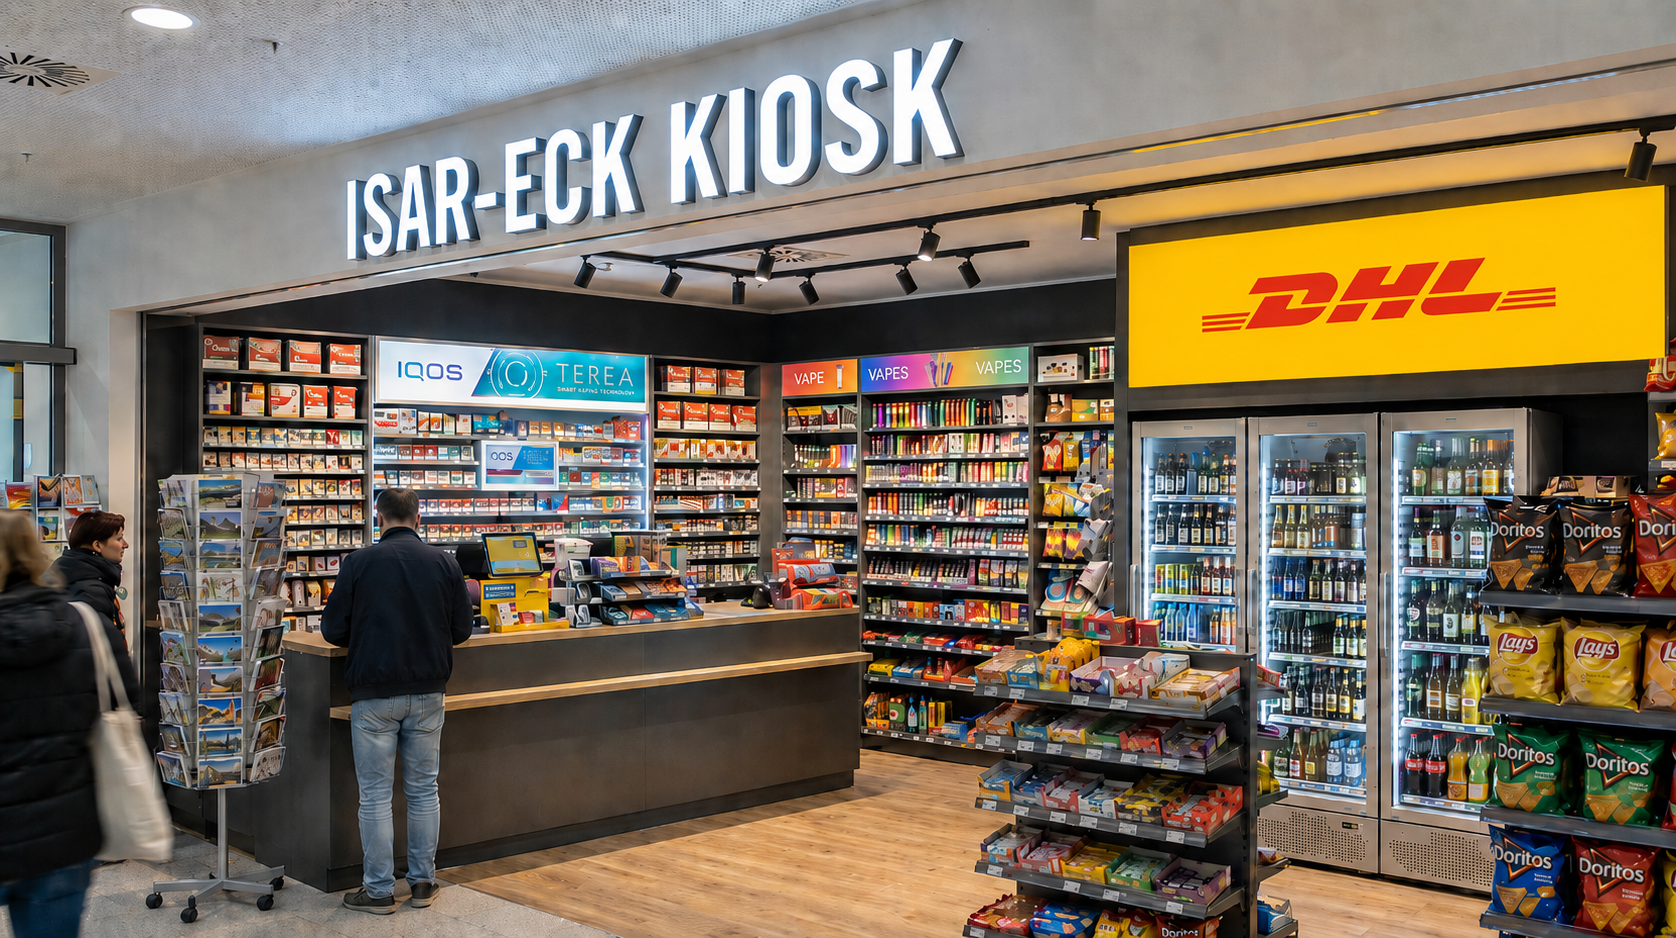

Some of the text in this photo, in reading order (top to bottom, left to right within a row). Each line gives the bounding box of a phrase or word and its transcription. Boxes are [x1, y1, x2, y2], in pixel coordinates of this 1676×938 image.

[347, 38, 965, 260] ISAR-ECK KIOSK
[1245, 257, 1503, 330] DHL
[398, 361, 463, 381] IQOS
[556, 363, 634, 387] TEREA
[794, 371, 824, 385] VAPE
[868, 359, 1022, 381] VAPES VAPES
[1491, 521, 1545, 538] Doritos
[1563, 522, 1622, 539] Doritos
[1499, 633, 1536, 654] Lays
[1577, 637, 1617, 659] Lays
[1498, 742, 1555, 766] Doritos
[1585, 752, 1650, 776] Doritos
[1494, 844, 1552, 870] Doritos
[1579, 857, 1645, 883] Doritos
